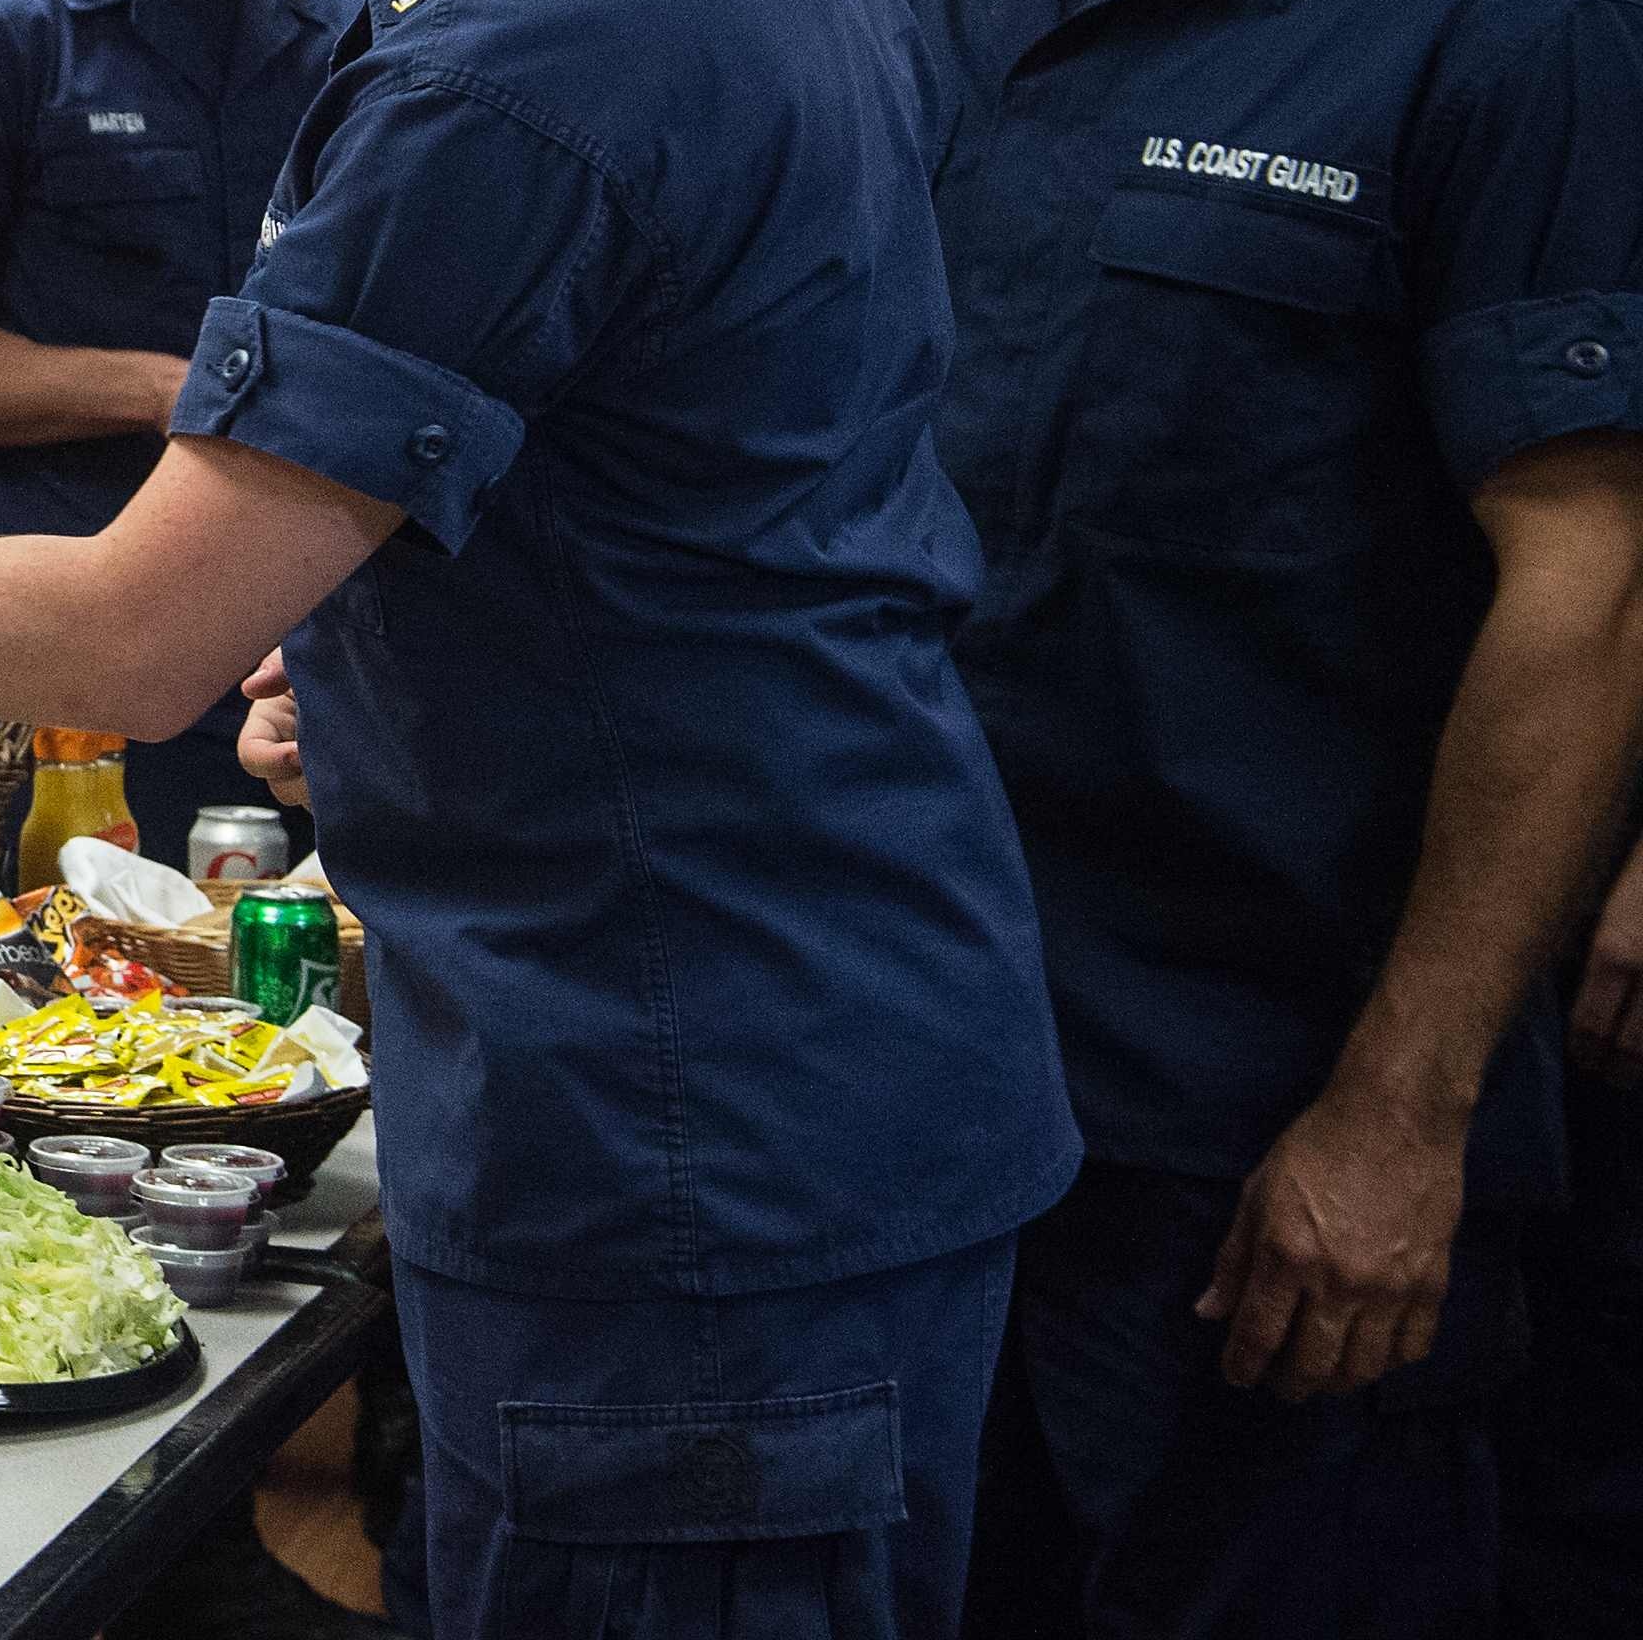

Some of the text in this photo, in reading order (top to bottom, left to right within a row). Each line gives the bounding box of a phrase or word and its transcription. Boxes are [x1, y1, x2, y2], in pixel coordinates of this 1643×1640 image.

[1142, 136, 1360, 203] U.S. COAST GUARD
